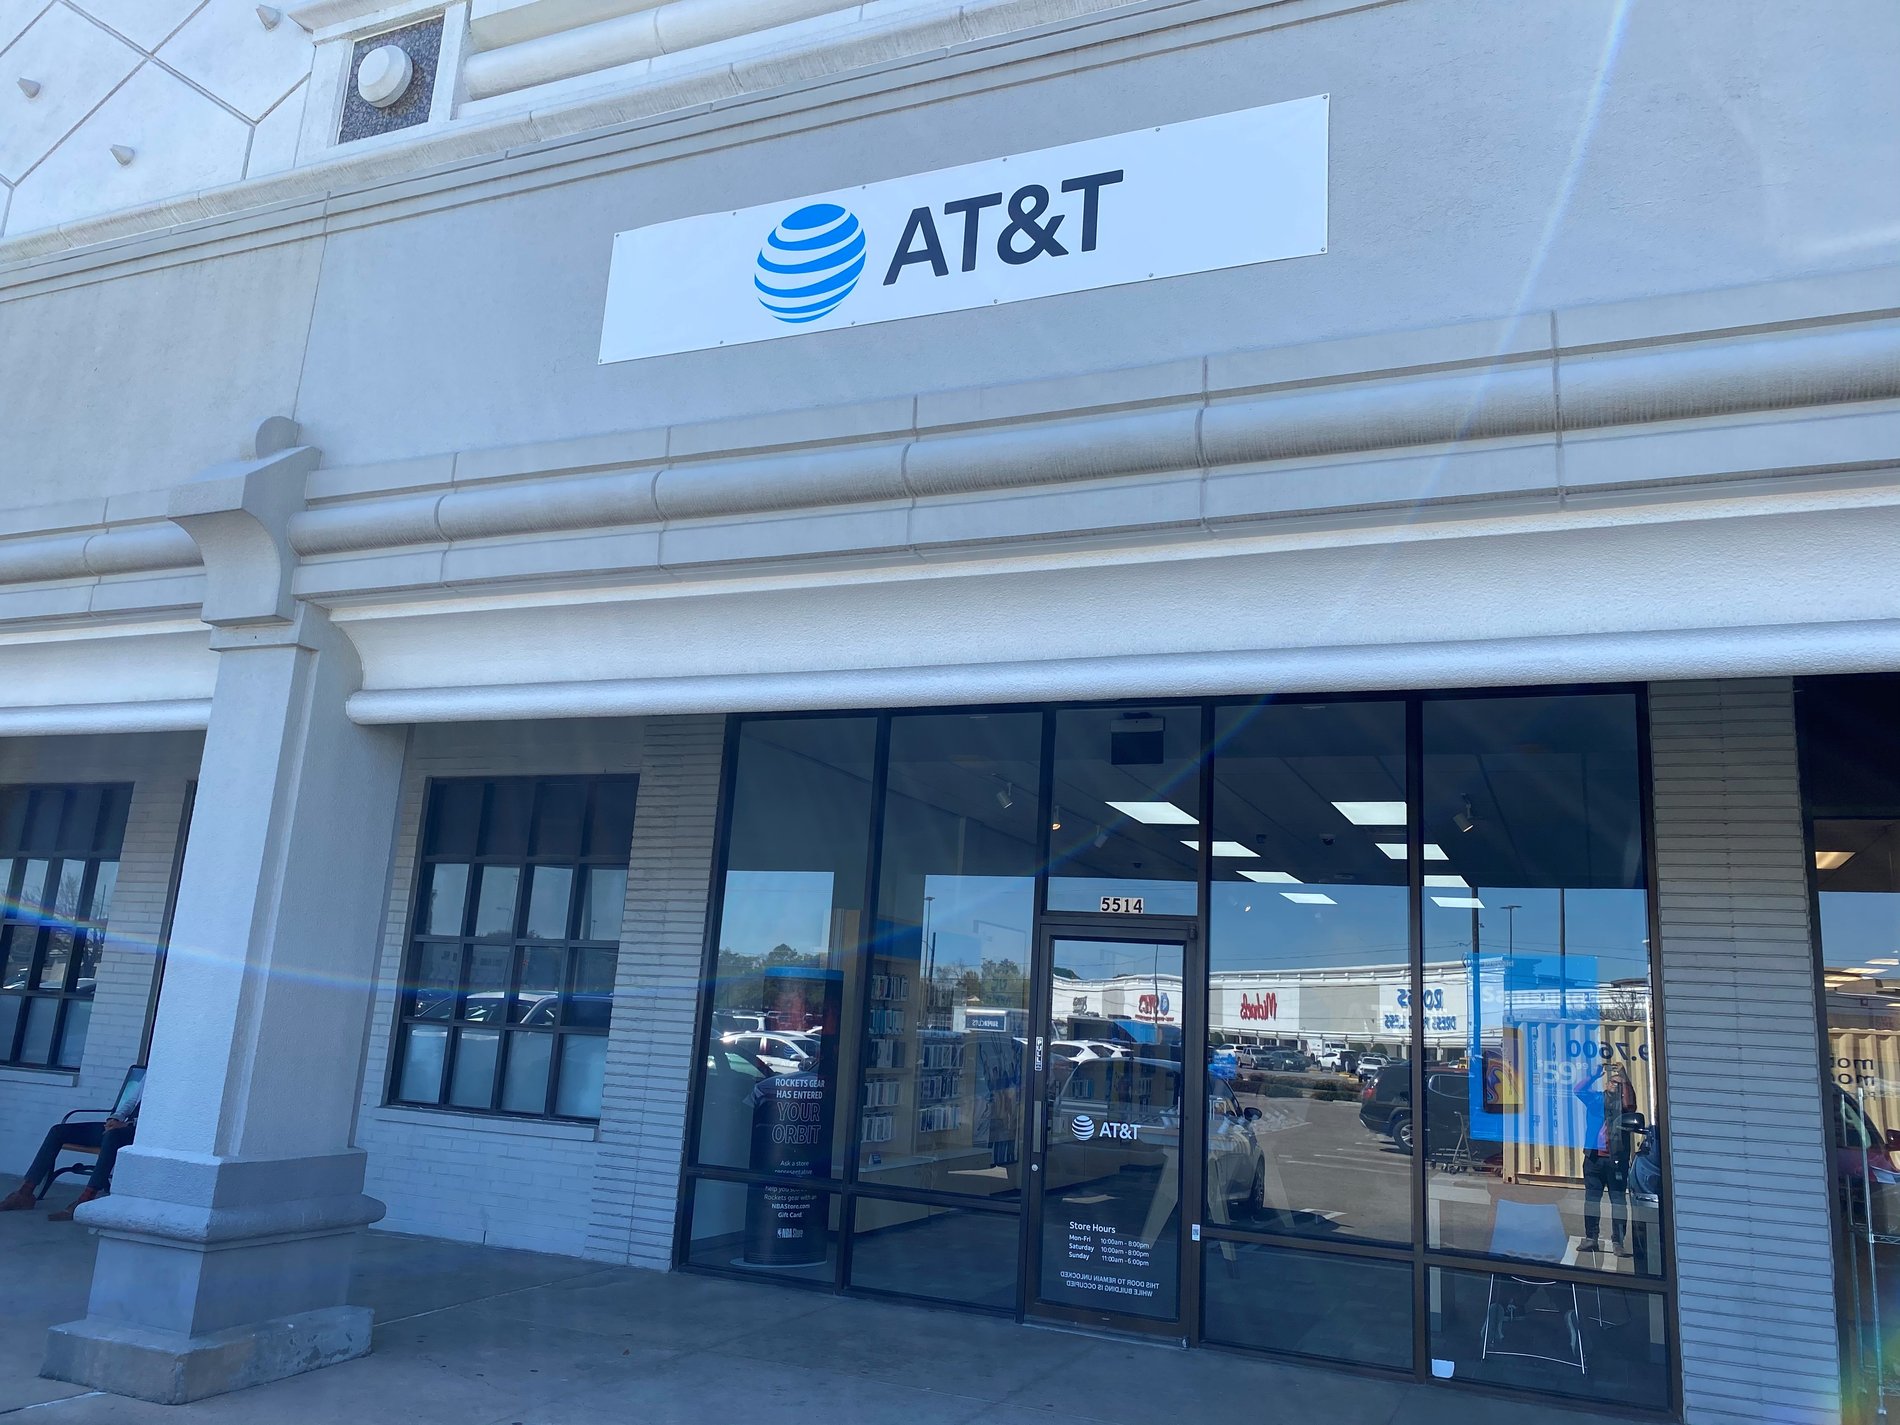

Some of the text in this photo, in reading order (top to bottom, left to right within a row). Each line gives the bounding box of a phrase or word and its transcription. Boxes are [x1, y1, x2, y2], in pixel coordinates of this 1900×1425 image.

[883, 168, 1124, 287] AT&T
[1101, 897, 1143, 914] 5514
[775, 1078, 826, 1088] ROCKETS GEAR
[776, 1090, 823, 1100] HAS ENTERED
[776, 1101, 821, 1122] YOUR
[771, 1123, 822, 1144] ORBIT
[1099, 1121, 1141, 1140] AT&T
[1069, 1221, 1116, 1234] Store Hours
[1068, 1234, 1091, 1243] Mon-Fri
[1100, 1238, 1123, 1246] 10:00am
[1128, 1240, 1150, 1250] 8:00pm
[1068, 1242, 1095, 1253] Saturday
[1101, 1246, 1124, 1255] 10:00am
[1127, 1249, 1150, 1258] 8:00pm
[1068, 1251, 1090, 1261] Sunday
